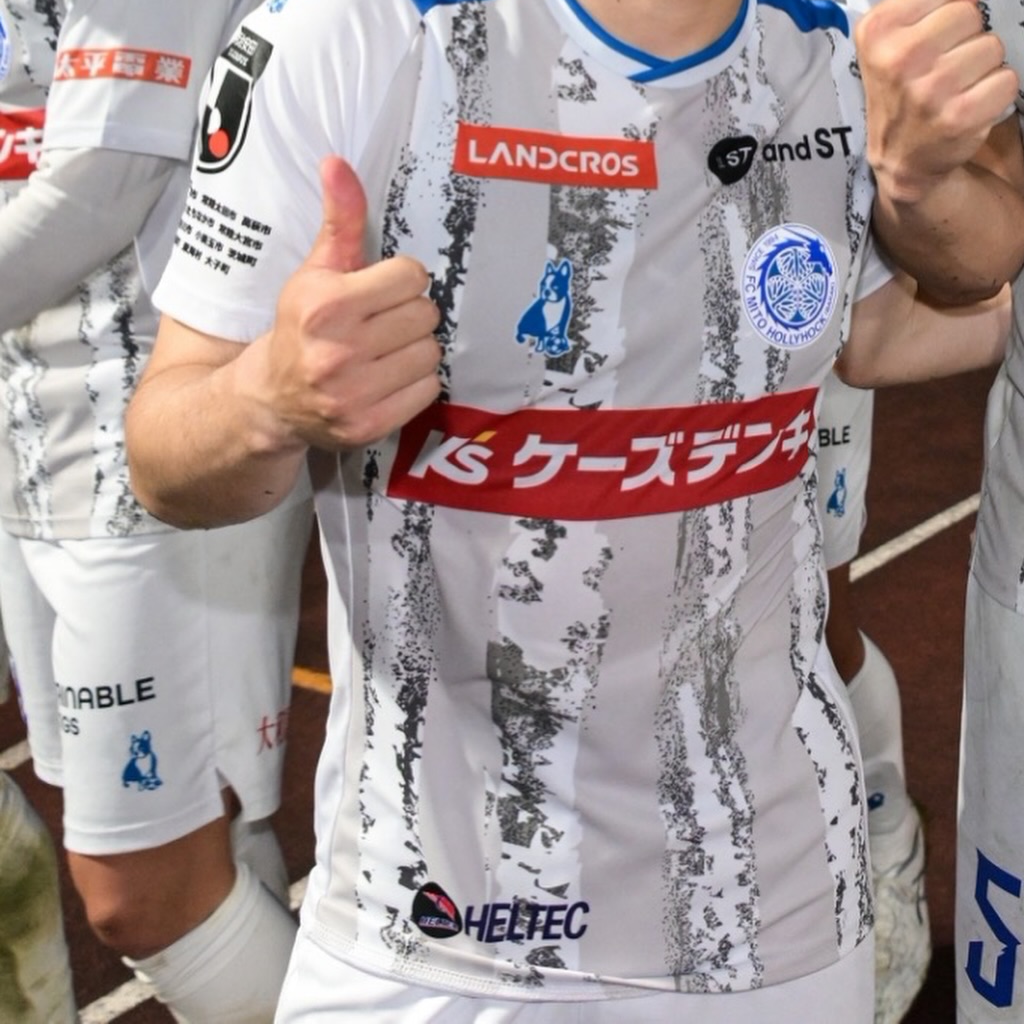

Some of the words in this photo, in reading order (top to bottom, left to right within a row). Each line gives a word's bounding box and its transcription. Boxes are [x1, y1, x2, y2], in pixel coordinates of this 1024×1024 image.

[468, 139, 640, 177] LANDCROS
[726, 146, 753, 167] ST
[762, 134, 812, 162] and
[814, 126, 853, 159] ST
[746, 294, 768, 329] MITO
[767, 316, 827, 345] HOLLYHOCK
[512, 410, 812, 492] ケーズデンキ
[56, 677, 156, 710] INABLE
[464, 901, 590, 943] HELTEC
